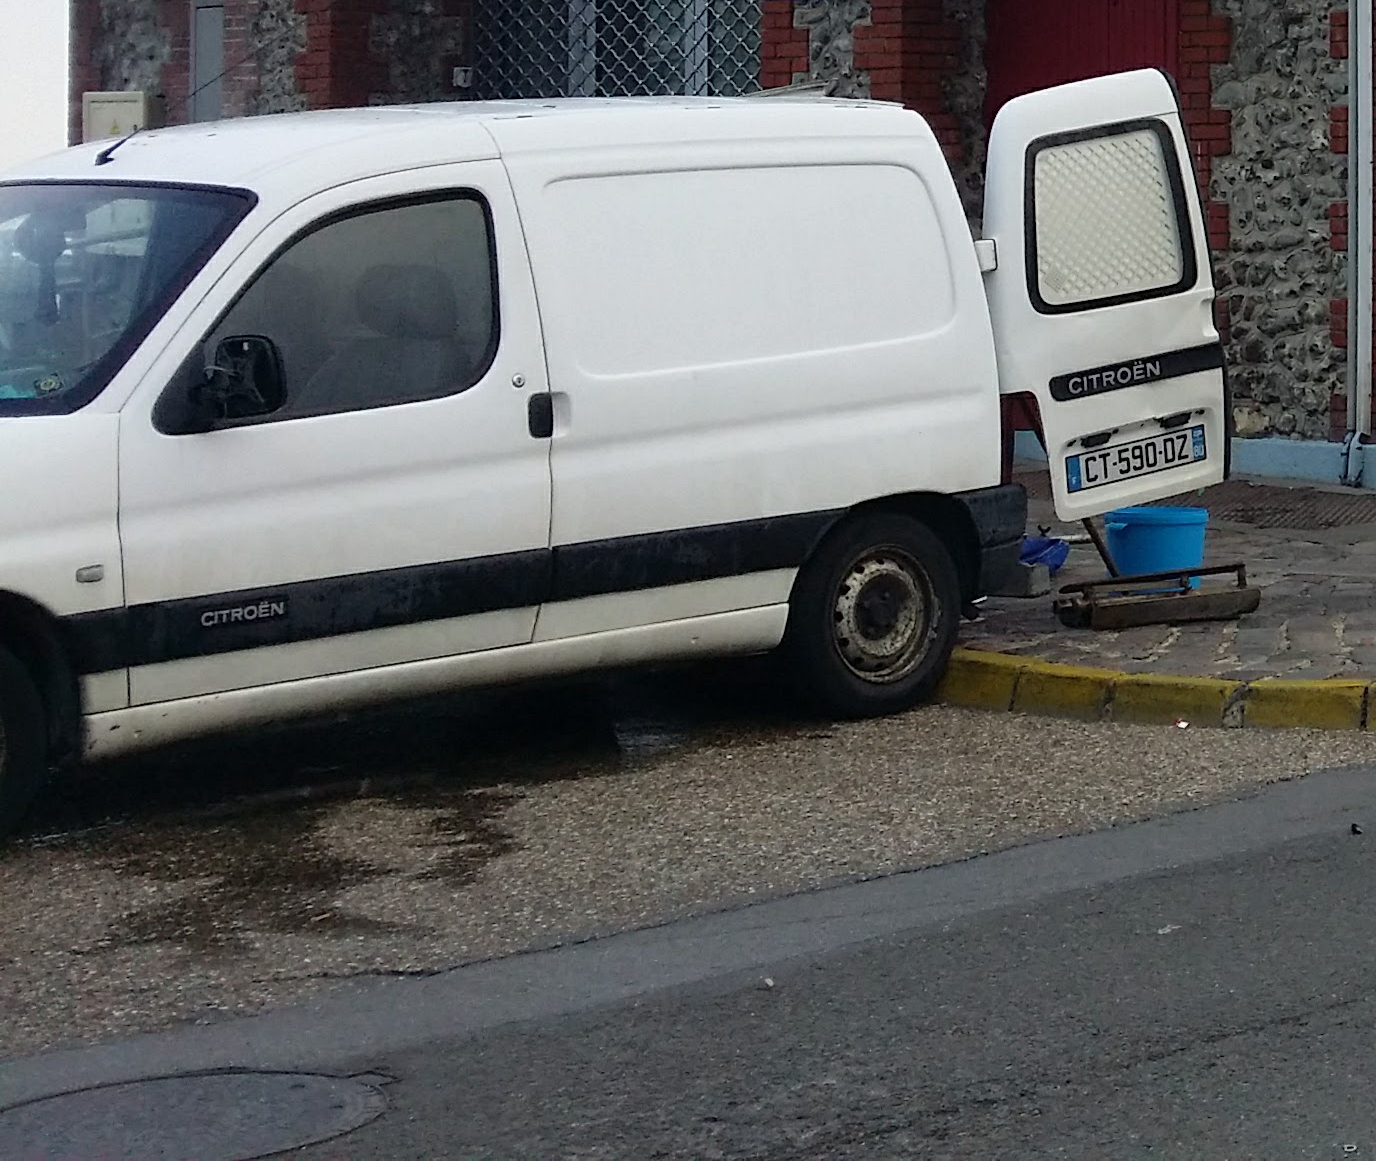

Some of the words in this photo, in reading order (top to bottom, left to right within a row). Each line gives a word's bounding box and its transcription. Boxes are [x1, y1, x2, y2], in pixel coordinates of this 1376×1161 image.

[1068, 360, 1161, 395] CITROËN
[1085, 434, 1189, 483] CT-590-DZ
[201, 601, 284, 627] CITROËN
